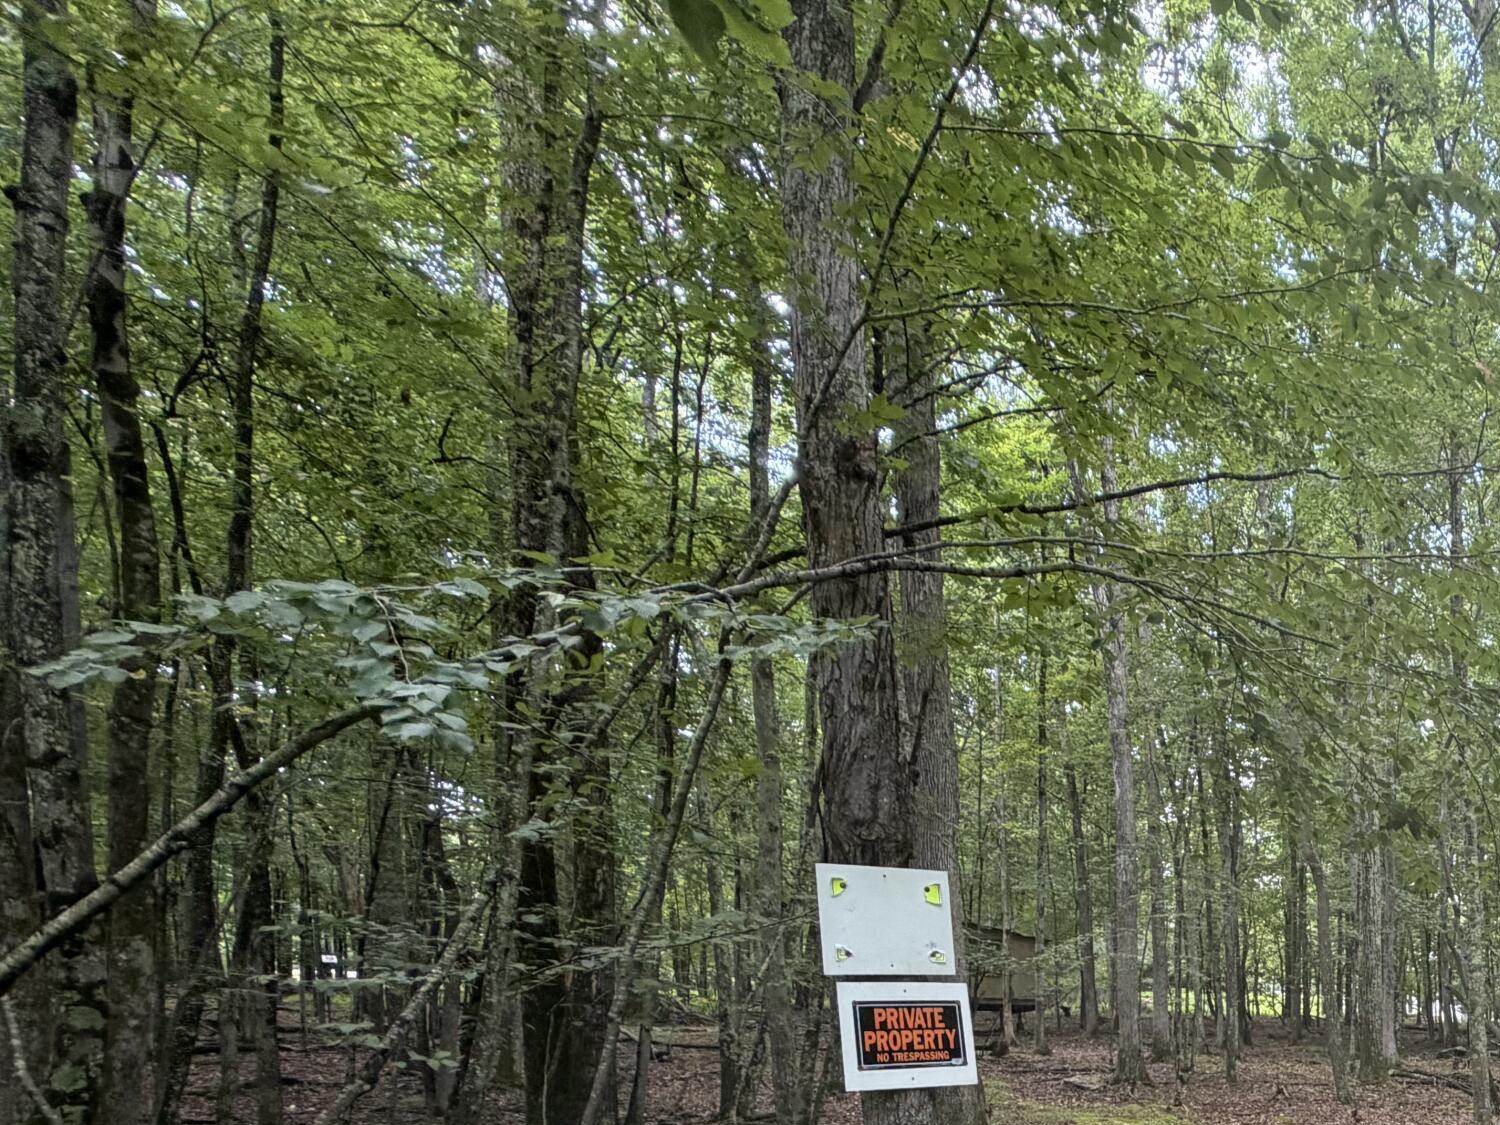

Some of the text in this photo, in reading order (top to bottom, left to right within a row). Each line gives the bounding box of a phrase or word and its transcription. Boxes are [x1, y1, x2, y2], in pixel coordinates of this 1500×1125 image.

[873, 1007, 946, 1029] PRIVATE
[863, 1028, 957, 1052] PROPERTY
[876, 1050, 950, 1063] NO TRESPASSING
